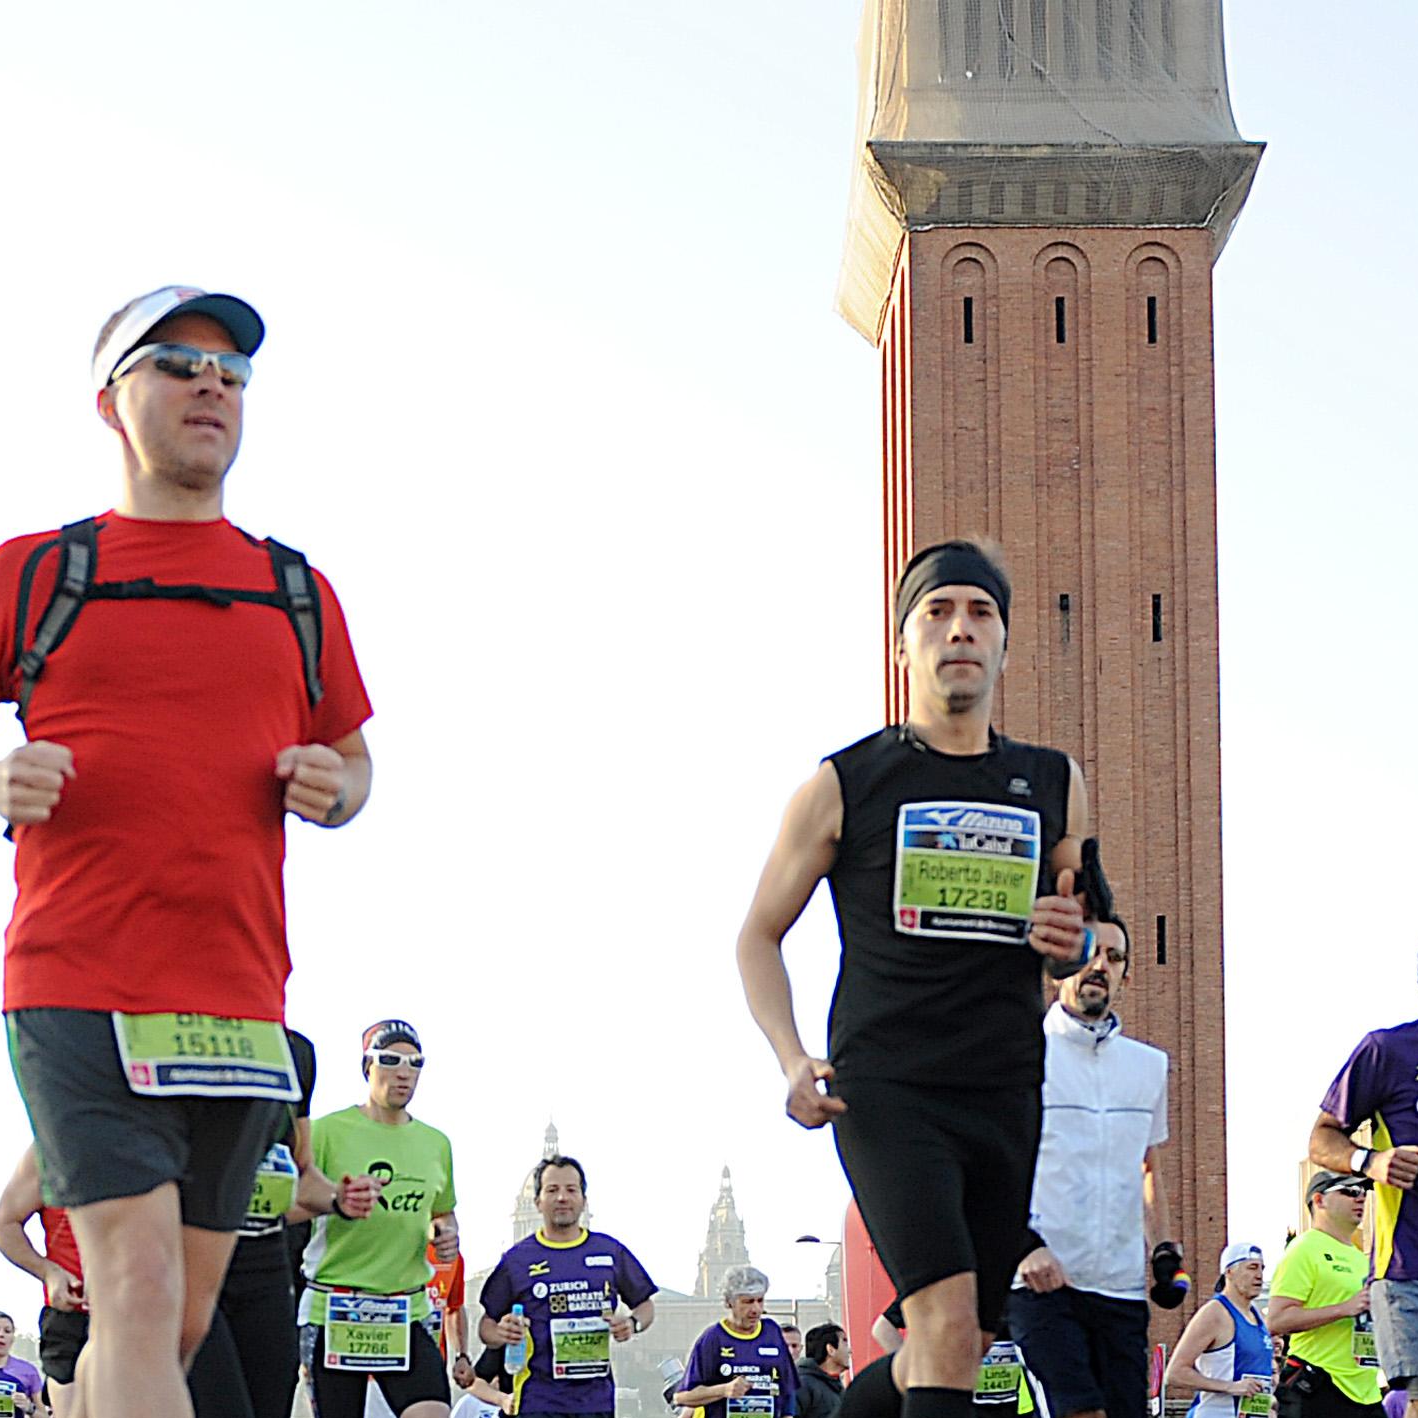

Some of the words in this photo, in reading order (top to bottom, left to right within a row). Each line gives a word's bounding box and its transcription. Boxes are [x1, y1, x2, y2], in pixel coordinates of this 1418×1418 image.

[919, 860, 982, 884] Roberto
[985, 864, 1026, 888] Javier
[938, 887, 1008, 912] 17238
[549, 1281, 589, 1293] ZURICH
[346, 1327, 392, 1341] Xavier
